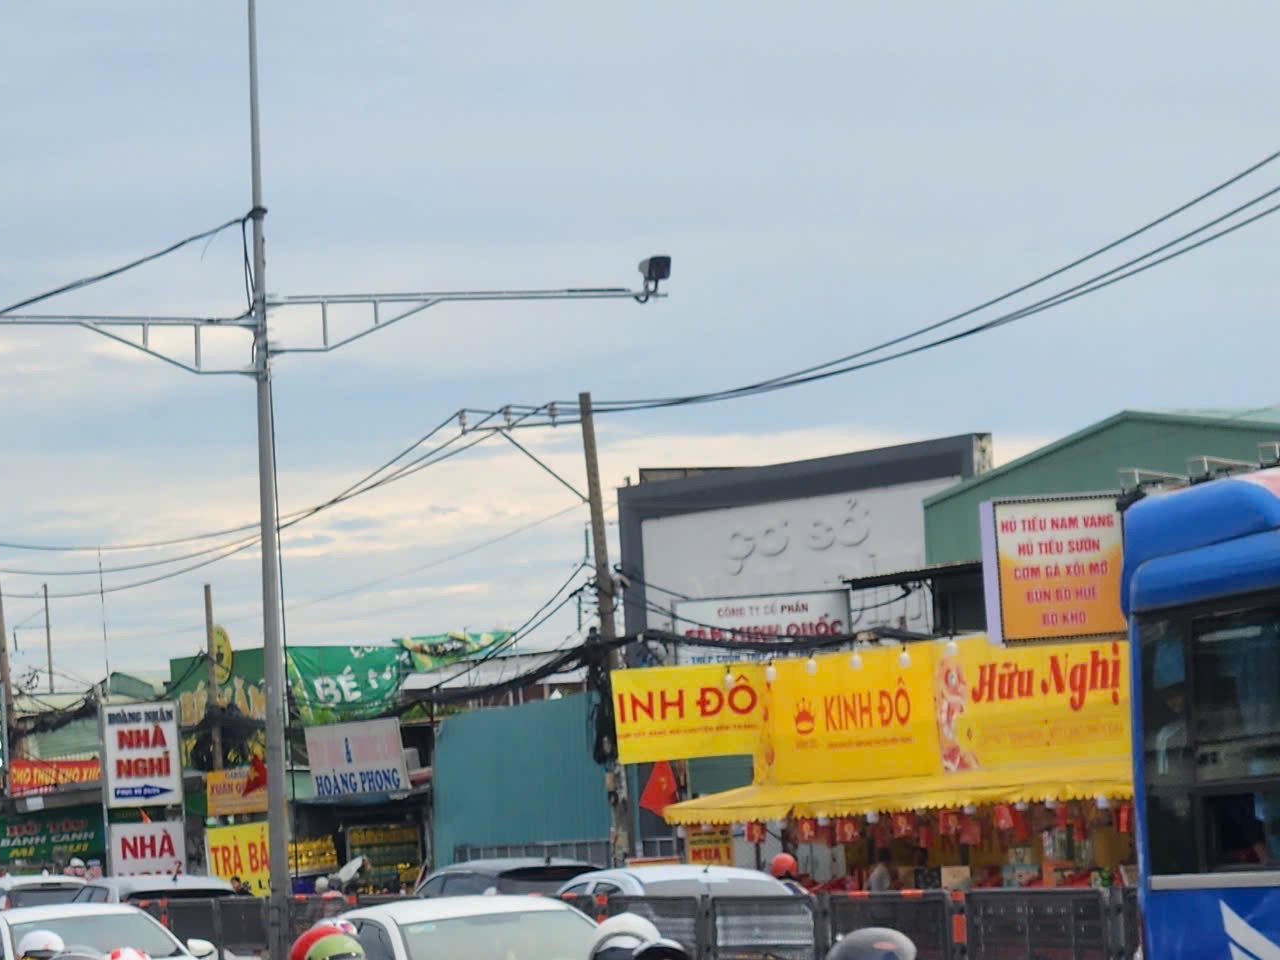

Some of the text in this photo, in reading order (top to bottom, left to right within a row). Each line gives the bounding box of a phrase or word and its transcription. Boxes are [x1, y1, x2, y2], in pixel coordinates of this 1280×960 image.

[1051, 516, 1078, 530] NAM
[972, 641, 1121, 712] Hữu Nghị
[696, 674, 758, 717] ĐÔ
[823, 674, 911, 732] KINH ĐÔ
[117, 721, 168, 750] NHÀ
[116, 750, 171, 780] NGHỈ
[315, 767, 401, 797] HOÀNG PHONG
[51, 831, 95, 844] CANH
[120, 828, 176, 861] NHÀ
